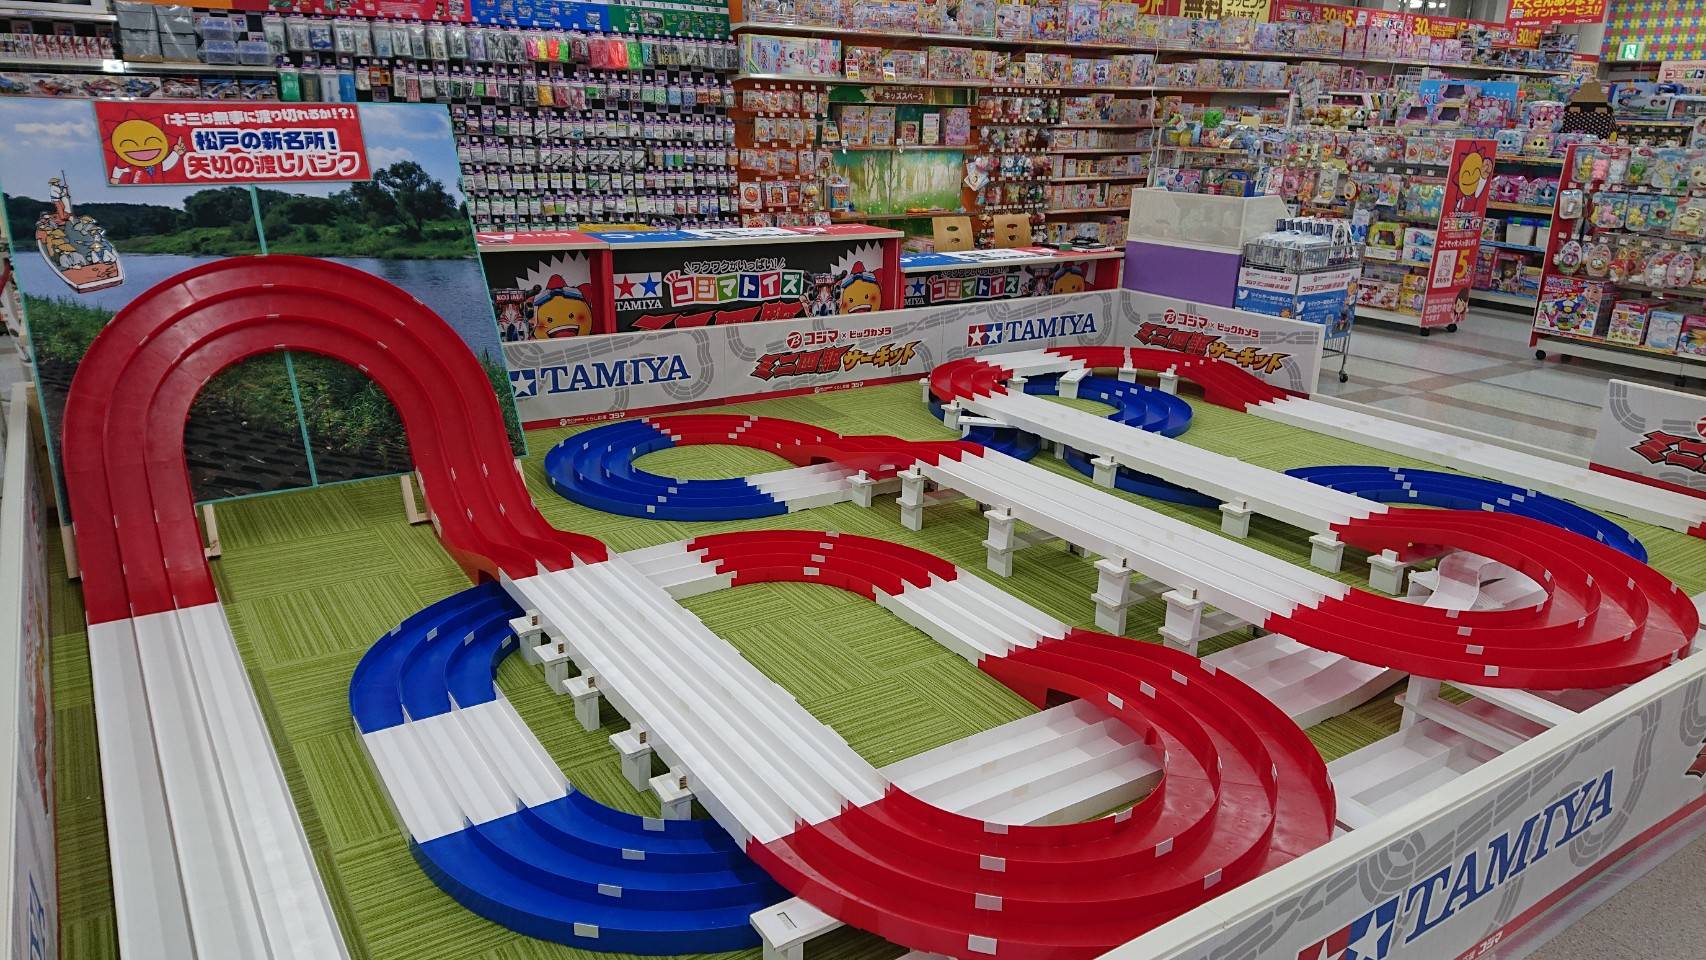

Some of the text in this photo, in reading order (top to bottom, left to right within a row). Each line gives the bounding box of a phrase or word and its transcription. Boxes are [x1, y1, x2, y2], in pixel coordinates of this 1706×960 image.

[186, 152, 358, 177] 矢切の渡しバンク
[672, 271, 803, 306] コジマトイズ
[904, 297, 925, 306] MIYA
[931, 275, 1020, 303] コジマトイズ
[615, 300, 663, 312] TAMIYA
[1005, 313, 1097, 343] TAMIYA
[541, 354, 691, 394] TAMIYA
[1403, 769, 1614, 944] TAMIYA
